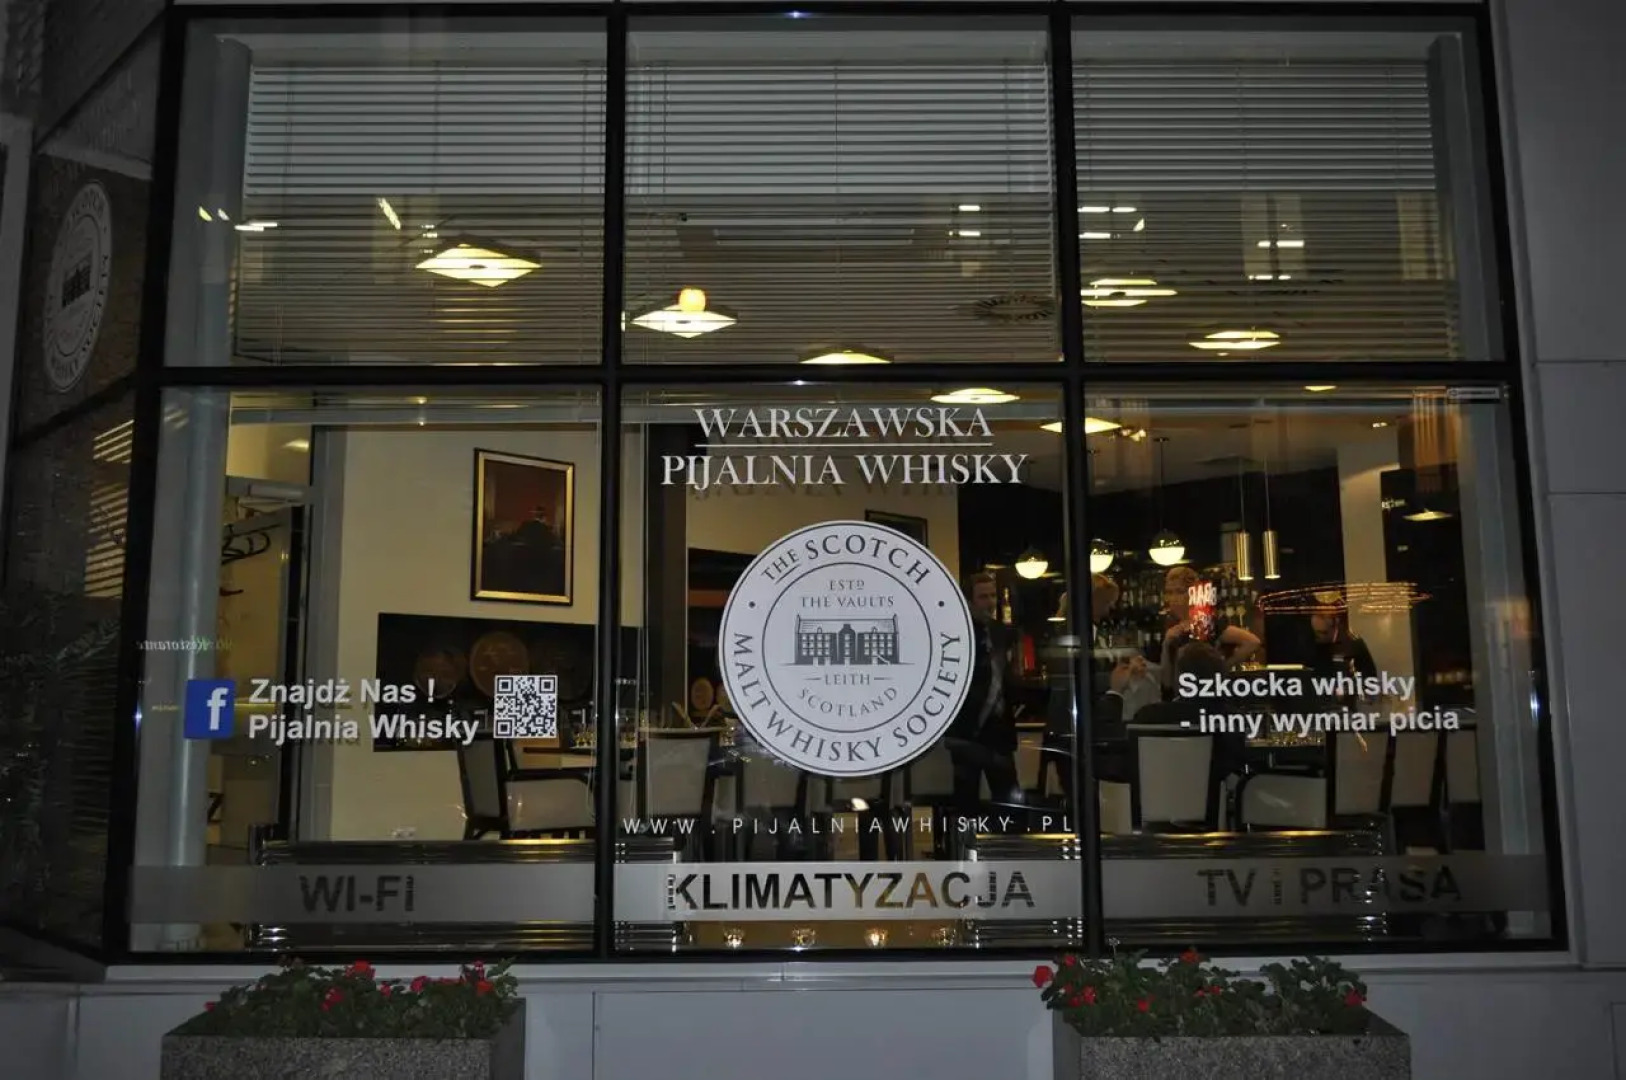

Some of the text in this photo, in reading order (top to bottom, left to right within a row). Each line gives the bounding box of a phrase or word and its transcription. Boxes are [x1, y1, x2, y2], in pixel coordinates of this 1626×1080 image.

[694, 407, 994, 439] WARSZAWSKA
[661, 454, 1029, 490] PIJALNIA WHISKY
[760, 533, 931, 587] THE SCOTCH
[801, 595, 895, 608] THE VAULTS
[360, 678, 416, 703] Nas
[824, 672, 871, 686] LEITH
[1178, 671, 1416, 703] Szkocka whisky
[733, 631, 962, 763] MALT WHISKY SOCIETY
[797, 687, 898, 719] SCOTLAND
[248, 713, 479, 745] Pijalnia Whisky
[1199, 708, 1263, 739] inny
[1271, 707, 1379, 737] wymiar
[1389, 706, 1459, 735] picia
[667, 871, 1036, 911] KLIMATYZACJA
[1197, 867, 1256, 907] TV
[1302, 864, 1463, 904] PRASA
